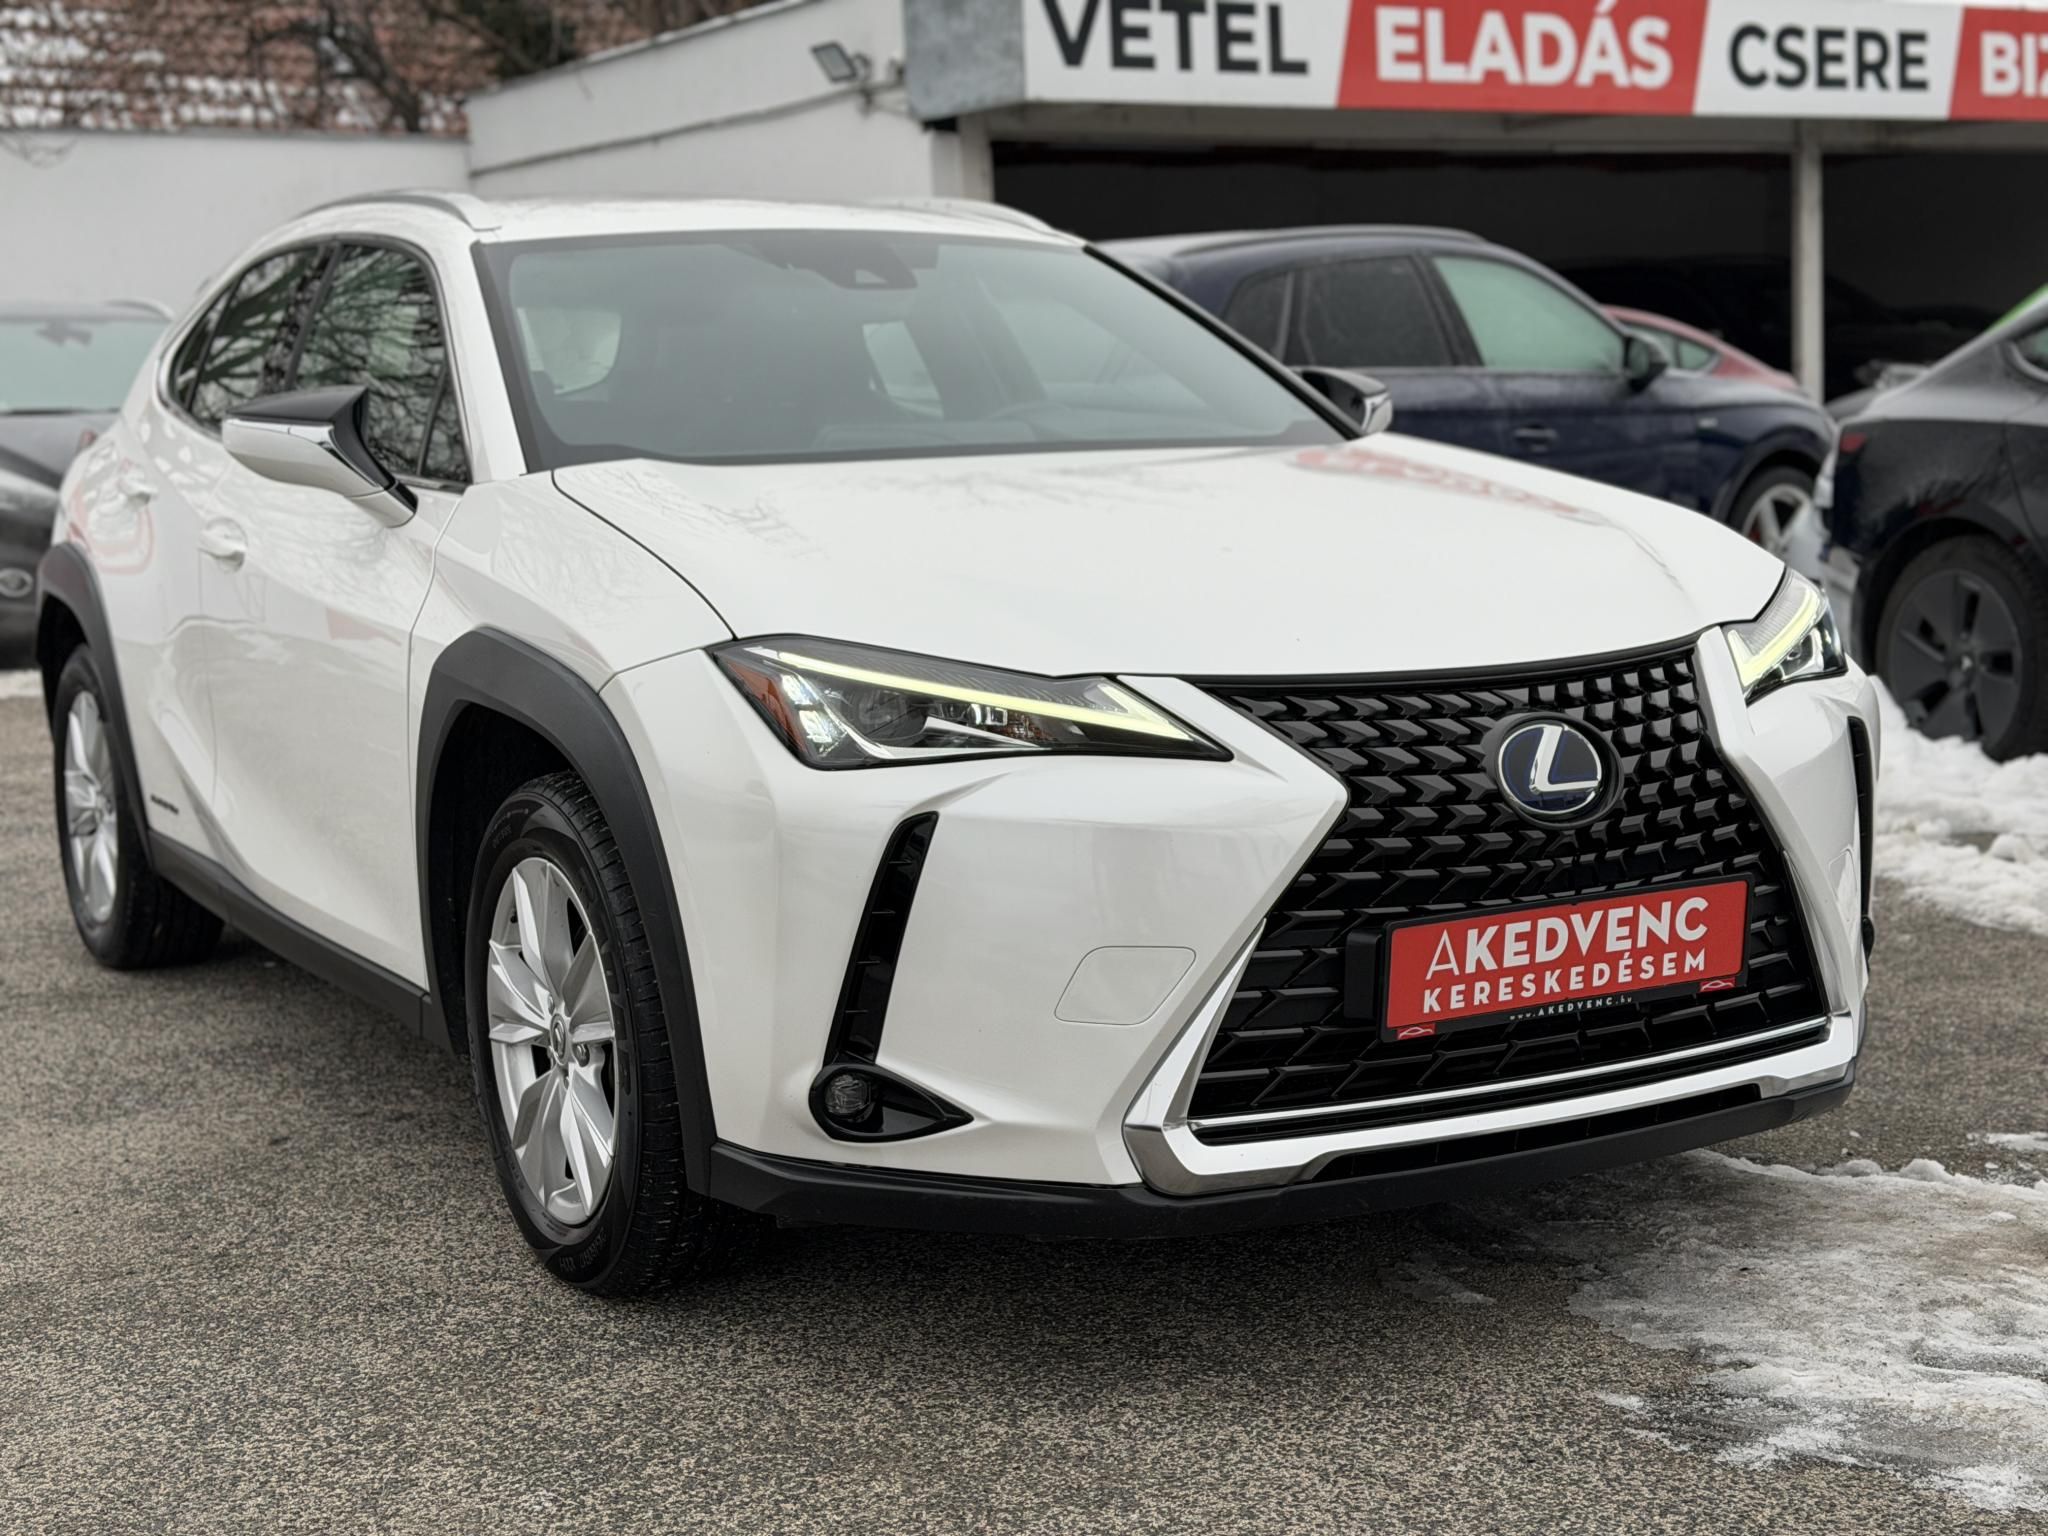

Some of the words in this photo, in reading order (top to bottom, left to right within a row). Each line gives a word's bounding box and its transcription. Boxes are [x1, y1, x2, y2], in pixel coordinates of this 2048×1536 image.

[1375, 0, 1673, 90] ELADÁS
[1729, 24, 1930, 91] CSERE
[1423, 947, 1706, 1014] KERESKEDÉSEM
